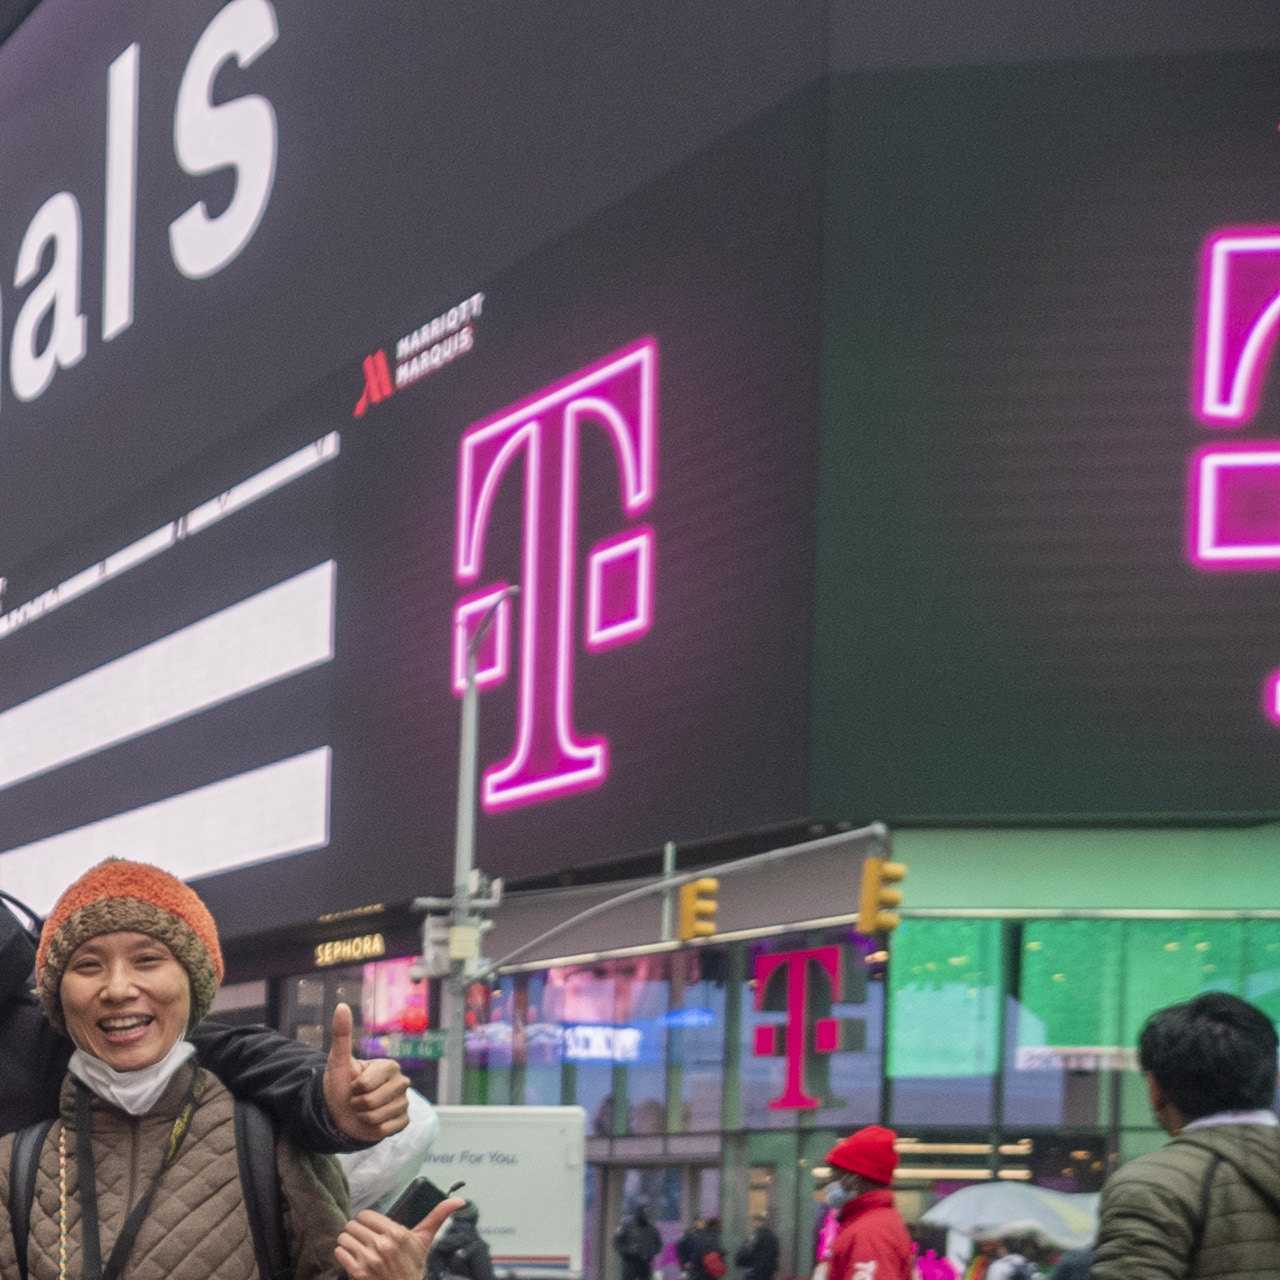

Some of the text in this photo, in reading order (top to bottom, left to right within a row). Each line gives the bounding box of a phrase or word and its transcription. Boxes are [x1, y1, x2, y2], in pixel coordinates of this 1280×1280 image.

[396, 291, 486, 360] MARRIOTT
[395, 326, 475, 387] MARQUIS
[315, 933, 385, 966] SEPHORA
[424, 1152, 456, 1164] liver
[459, 1150, 485, 1164] For
